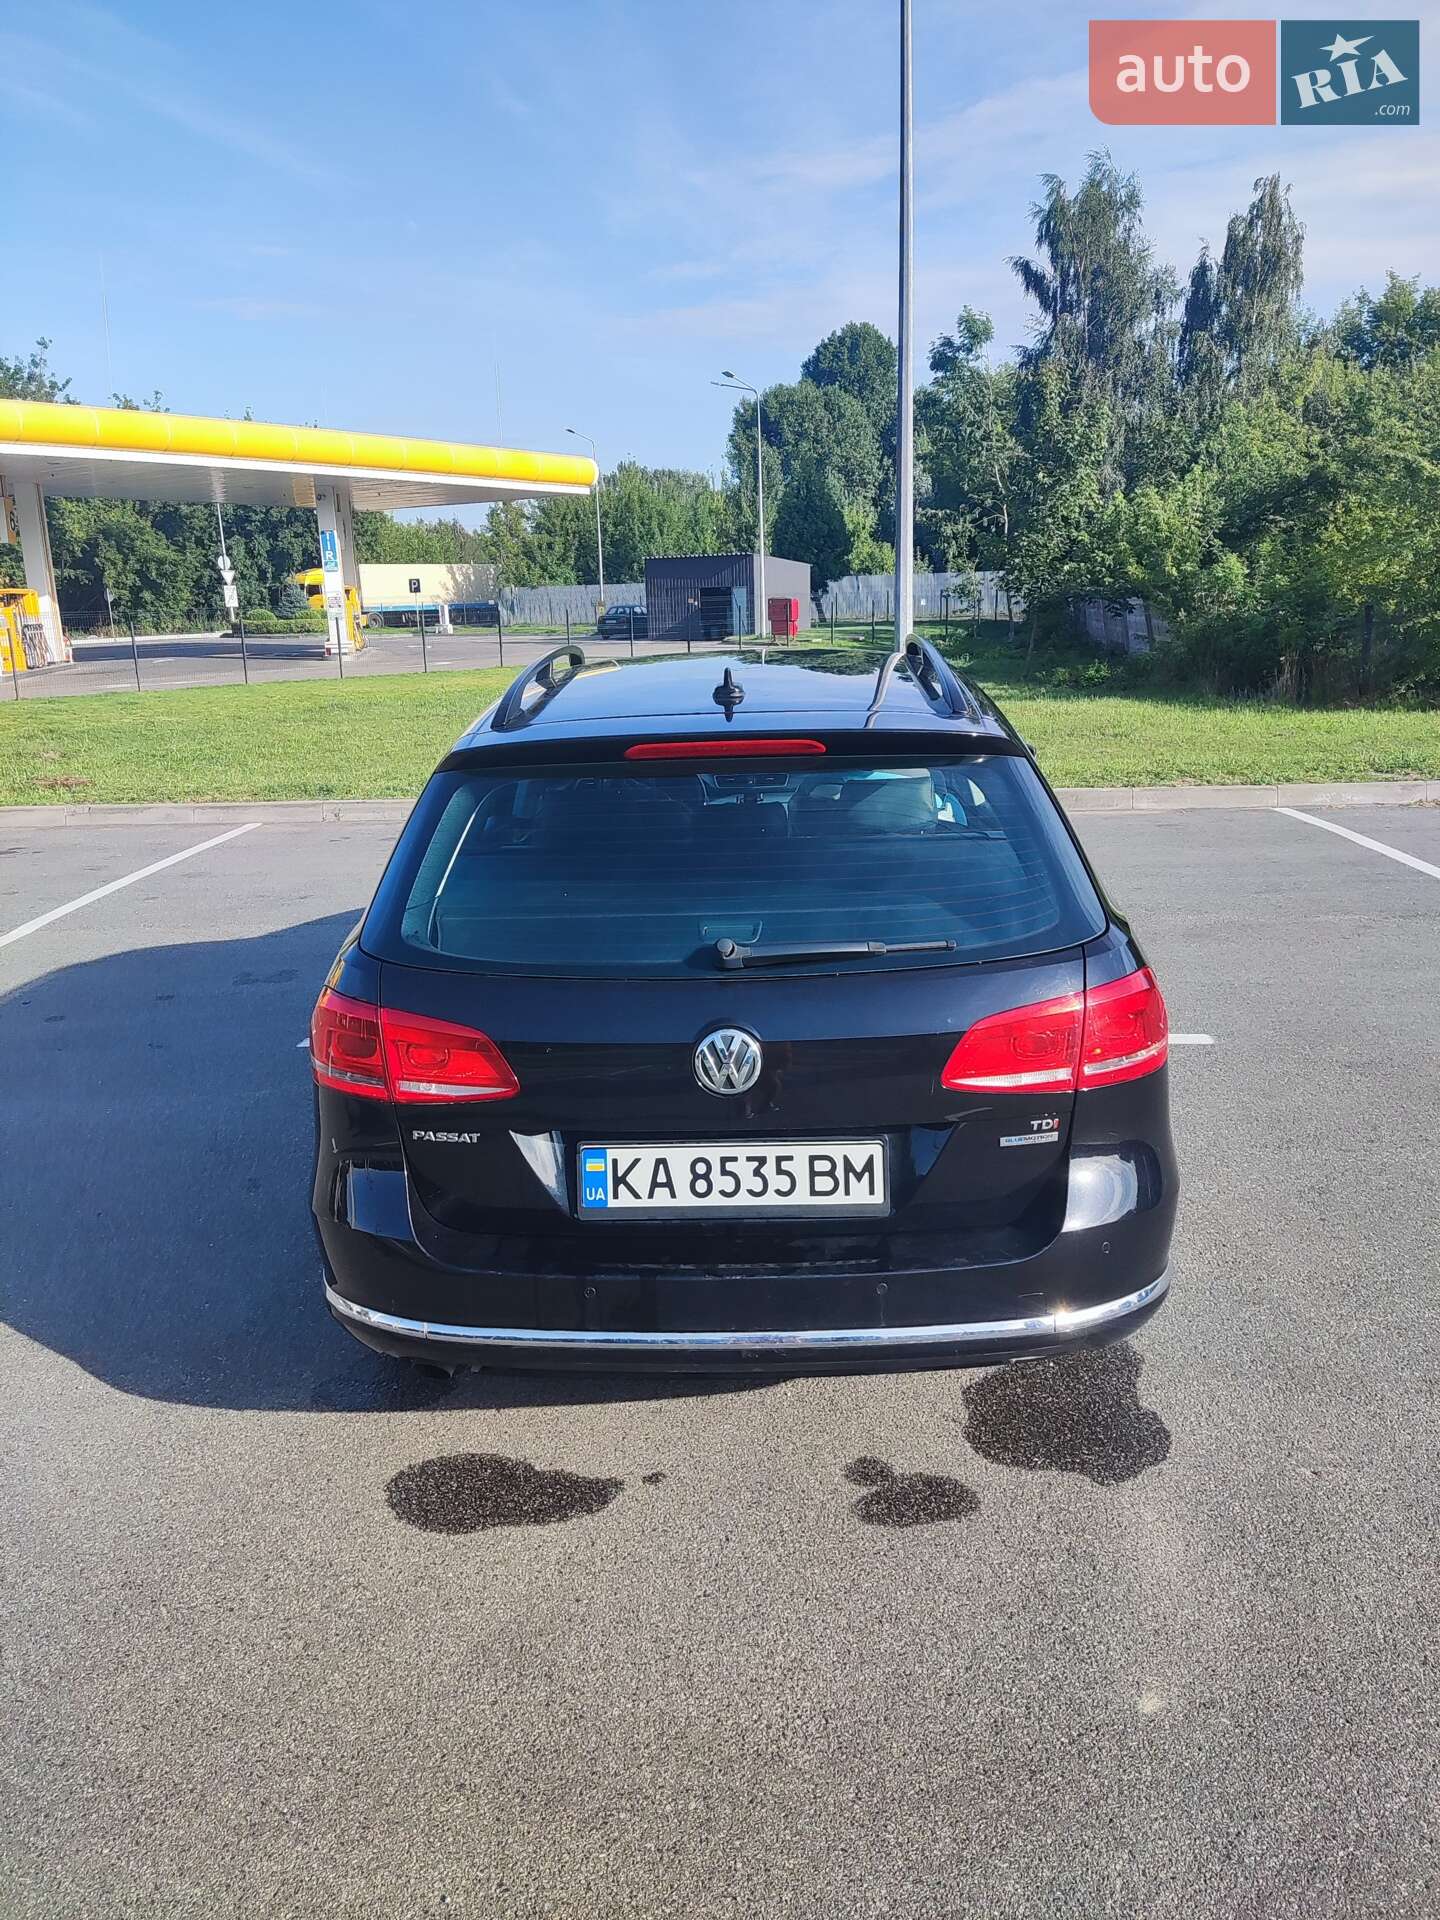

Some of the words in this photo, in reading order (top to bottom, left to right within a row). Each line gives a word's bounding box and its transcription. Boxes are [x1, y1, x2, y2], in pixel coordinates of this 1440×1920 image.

[412, 1130, 481, 1143] PASSAT
[611, 1157, 677, 1200] KA
[689, 1155, 797, 1199] 8535
[808, 1153, 875, 1197] BM
[586, 1187, 605, 1200] UA
